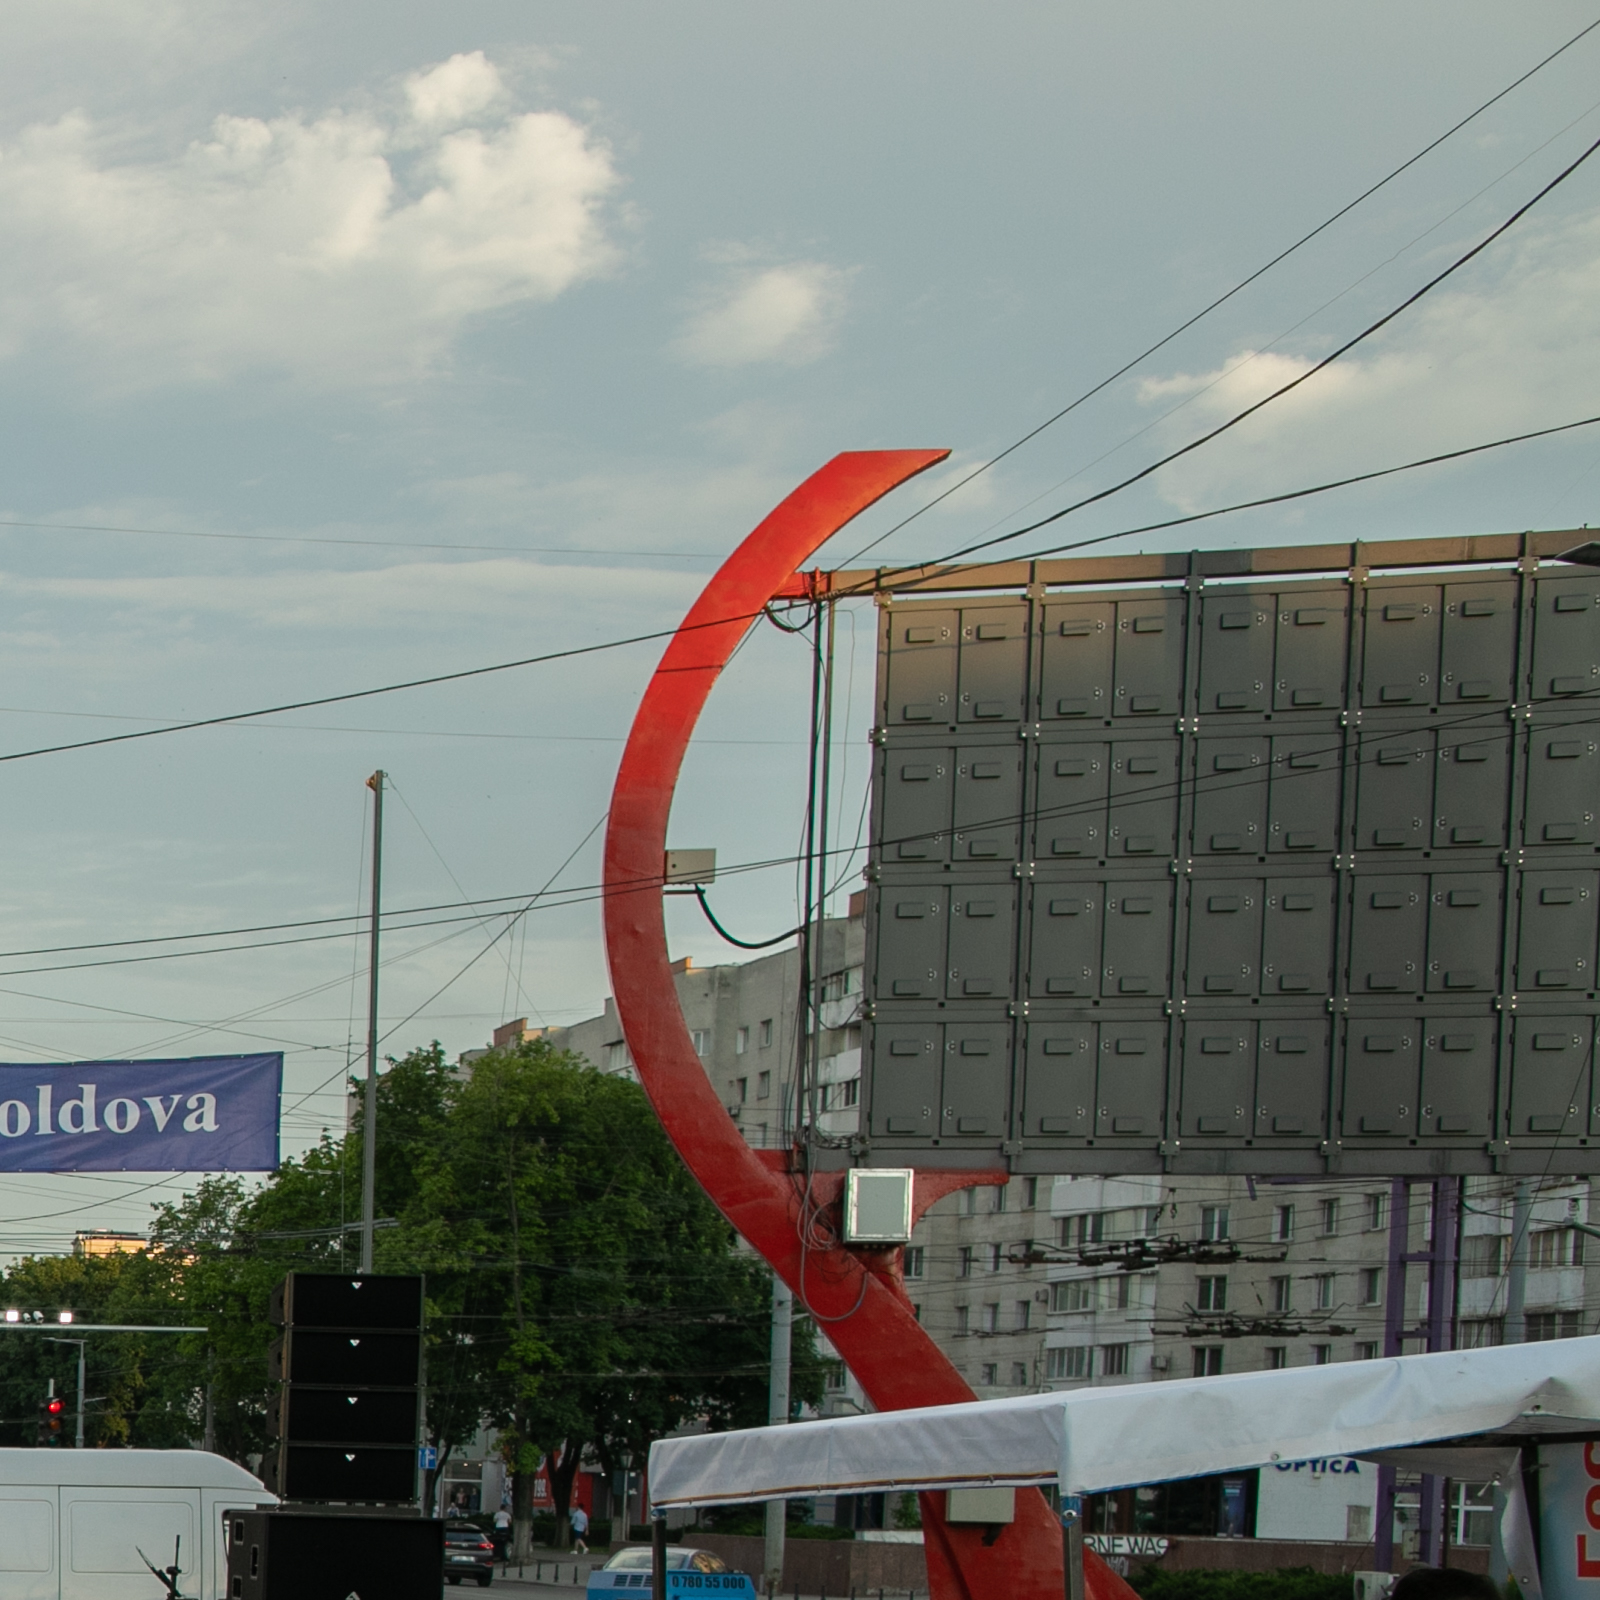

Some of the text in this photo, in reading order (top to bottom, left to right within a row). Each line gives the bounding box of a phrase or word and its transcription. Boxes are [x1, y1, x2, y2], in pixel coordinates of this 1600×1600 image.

[672, 1576, 745, 1589] 0 780 55 000
